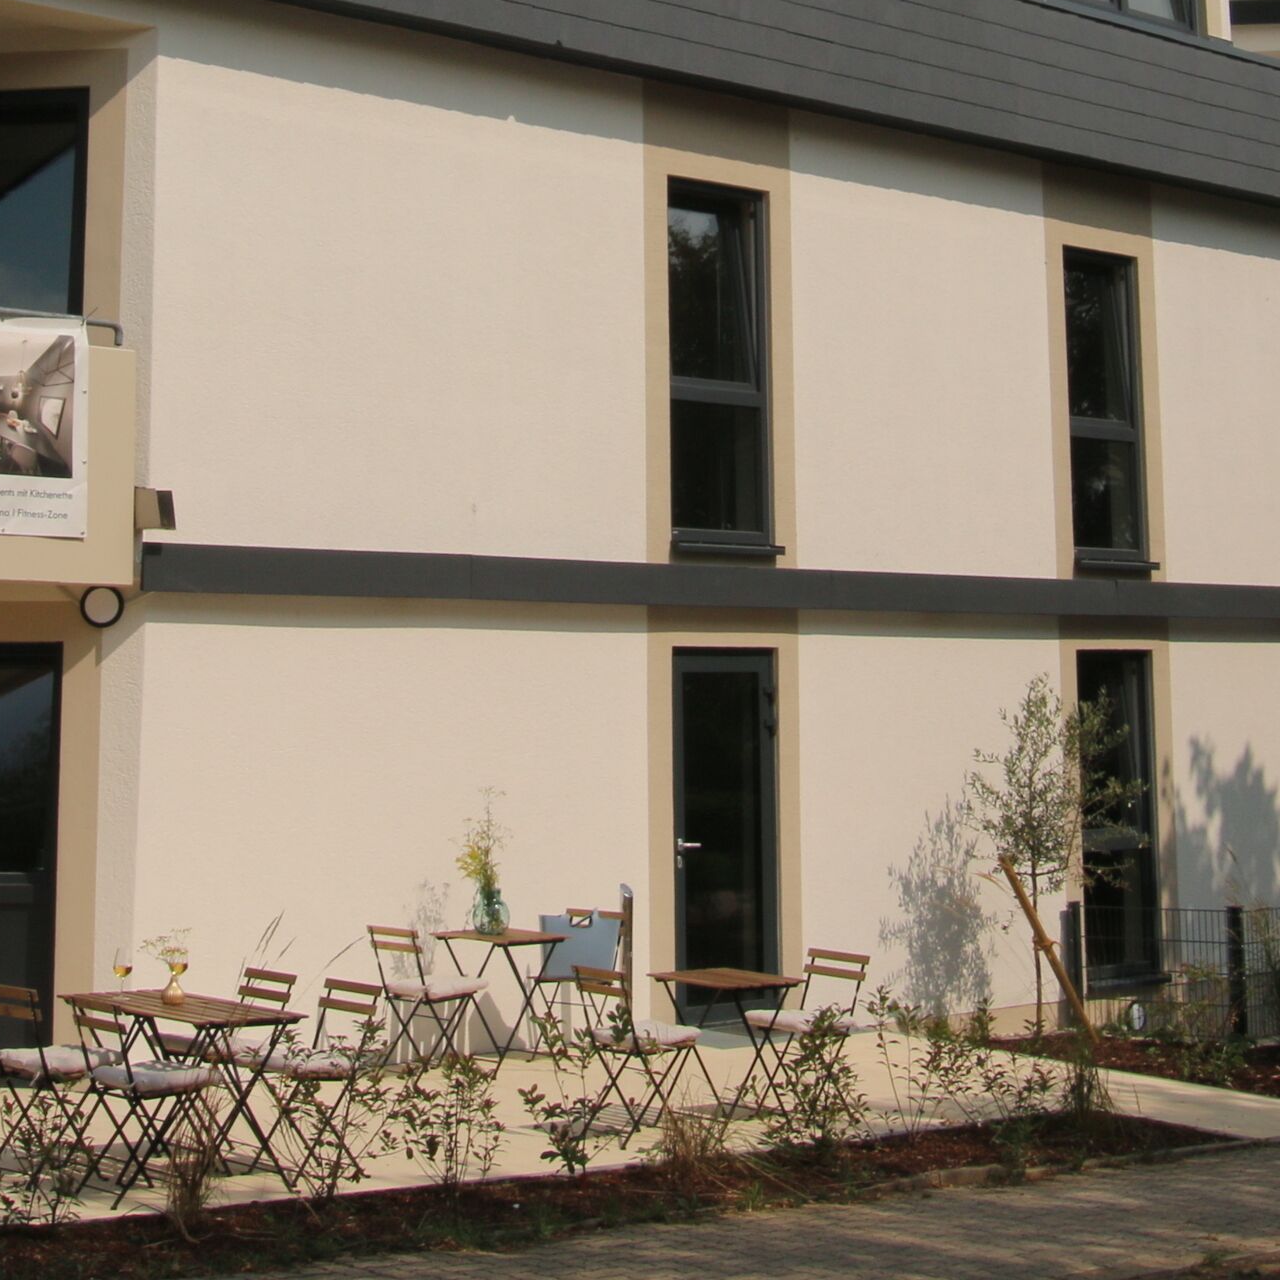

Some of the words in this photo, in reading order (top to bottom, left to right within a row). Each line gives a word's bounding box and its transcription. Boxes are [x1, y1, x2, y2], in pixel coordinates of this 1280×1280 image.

[17, 488, 28, 497] mit
[29, 489, 73, 500] Kitchenette
[17, 508, 69, 520] Fitness-Zone
